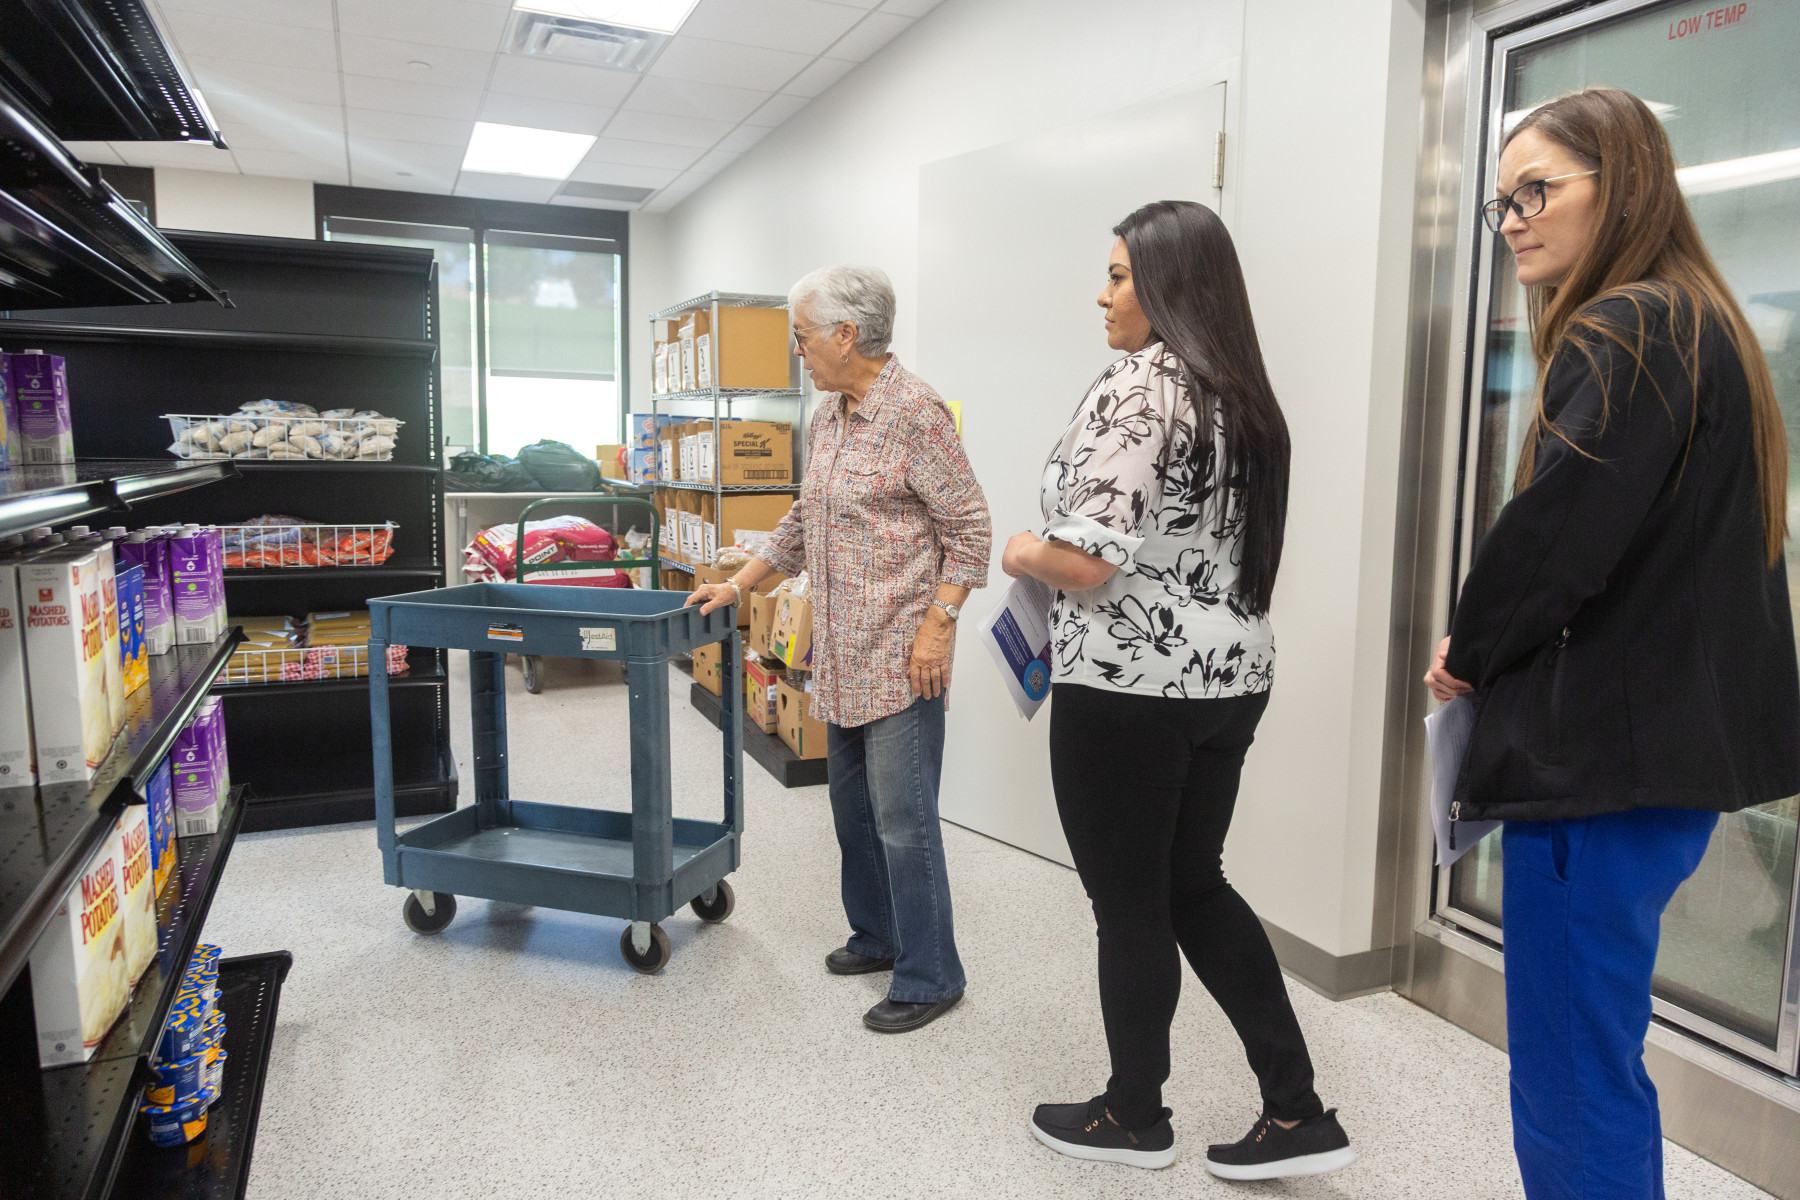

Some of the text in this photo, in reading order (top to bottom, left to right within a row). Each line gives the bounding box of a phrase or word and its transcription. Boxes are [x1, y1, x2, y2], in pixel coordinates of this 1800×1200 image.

[1668, 2, 1748, 40] LOW TEMP
[528, 546, 556, 564] POINT
[27, 615, 70, 628] POTATOES
[28, 605, 66, 617] MASHED
[81, 857, 115, 911] MASHED
[80, 884, 119, 945] POTATOES
